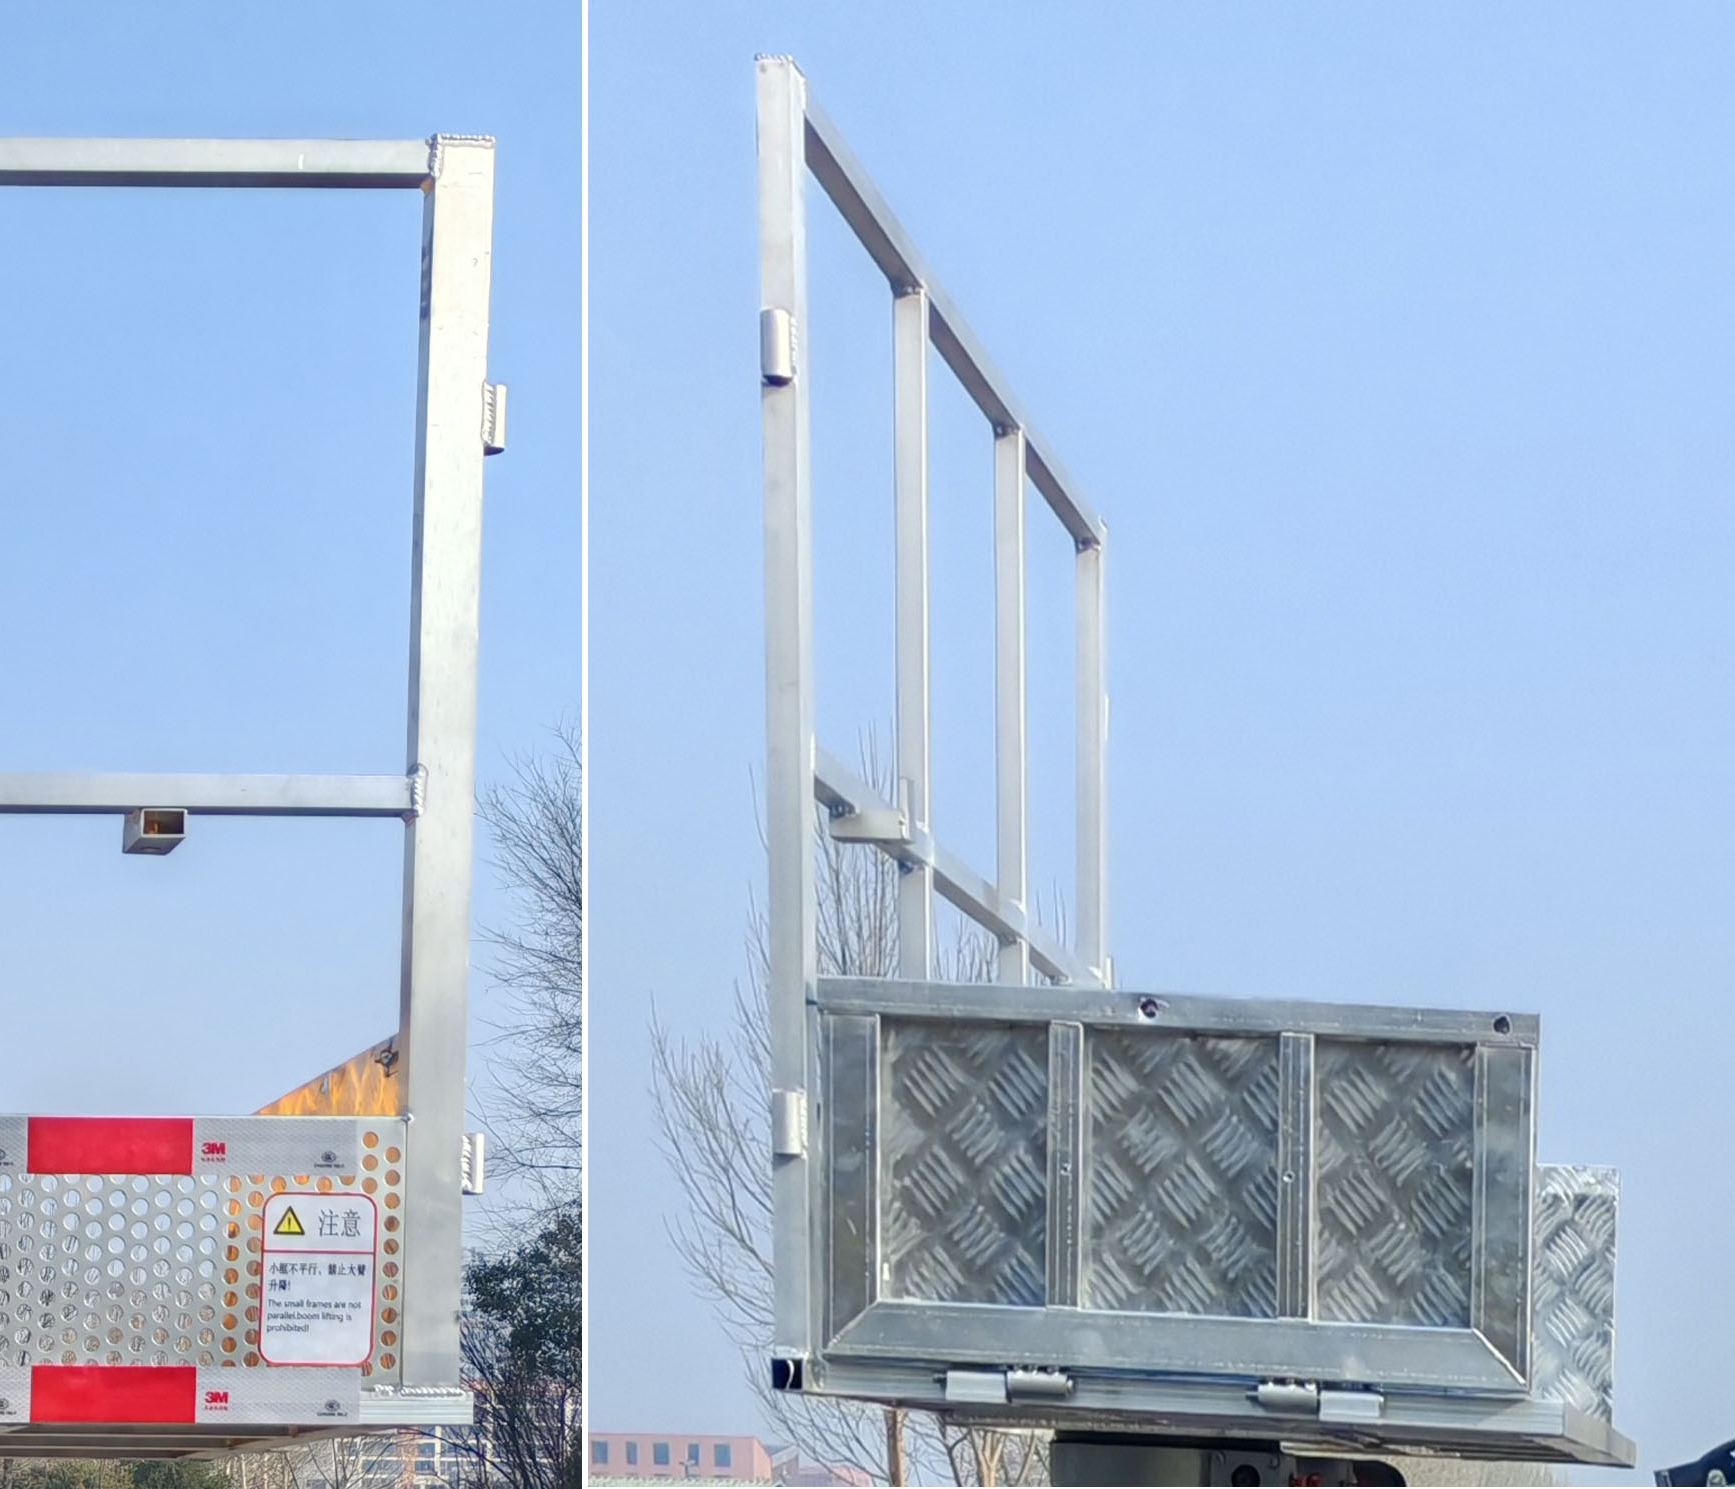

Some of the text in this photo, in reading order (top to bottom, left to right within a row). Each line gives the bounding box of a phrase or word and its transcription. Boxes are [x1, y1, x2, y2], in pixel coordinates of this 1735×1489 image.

[201, 1141, 225, 1154] 3M
[318, 1208, 361, 1237] 注意
[268, 1299, 362, 1309] The small frames are not
[322, 1311, 344, 1323] lifting
[346, 1312, 352, 1321] is
[204, 1390, 228, 1403] 3M
